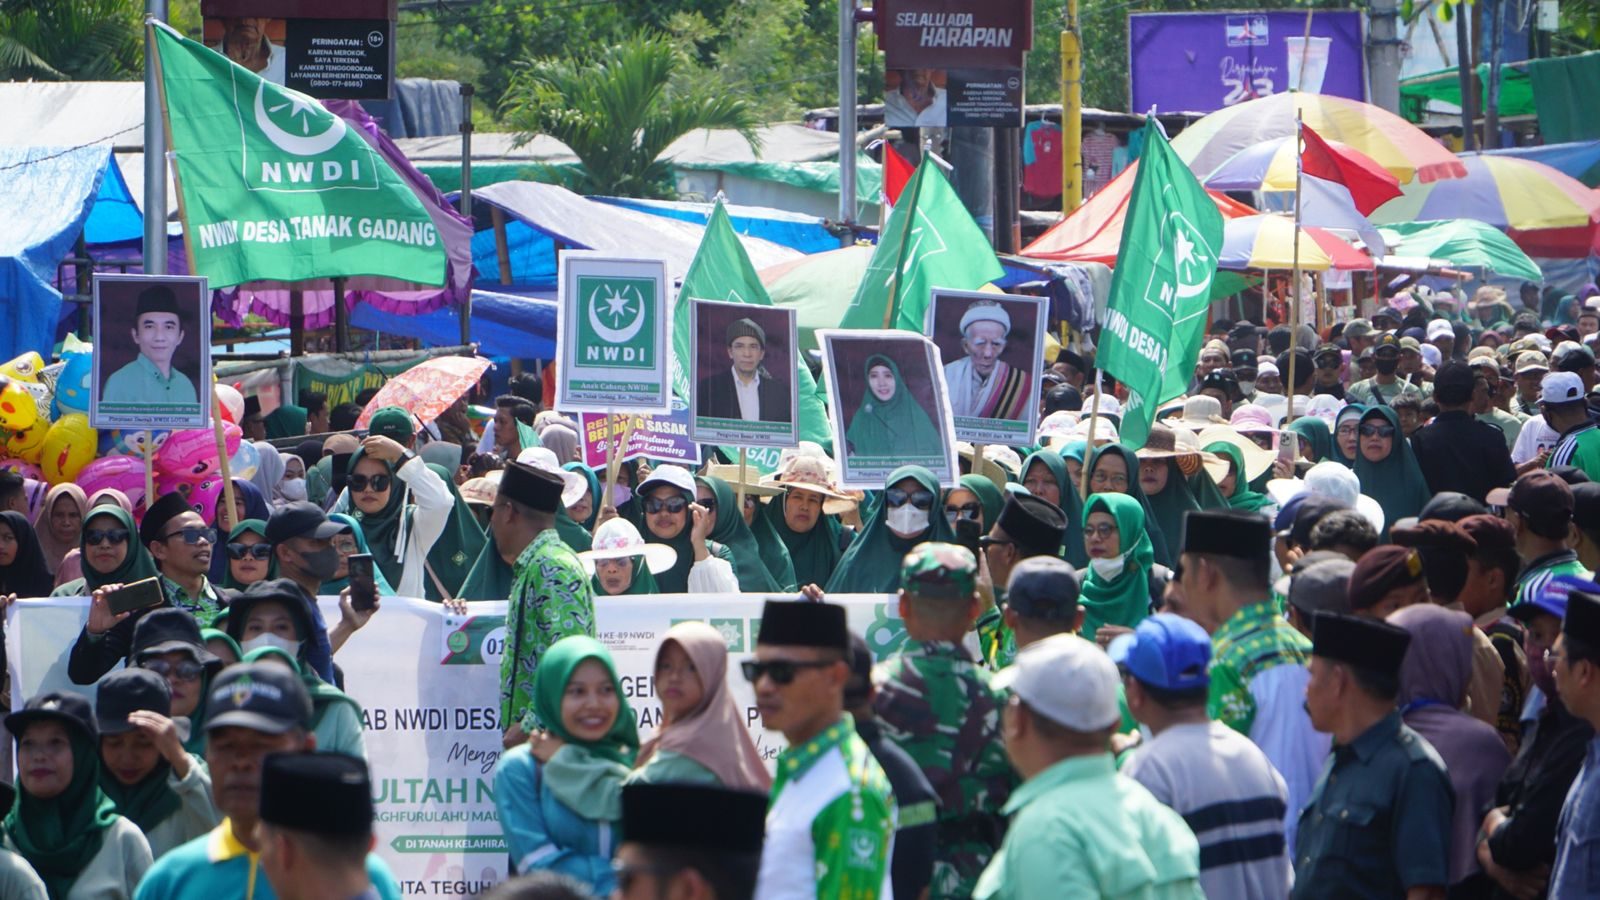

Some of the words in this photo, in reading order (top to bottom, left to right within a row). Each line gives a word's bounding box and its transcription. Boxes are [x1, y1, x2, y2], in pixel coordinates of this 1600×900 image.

[896, 12, 945, 27] SELALU
[947, 13, 973, 27] ADA
[311, 38, 359, 46] PERINGATAN
[920, 27, 1012, 48] HARAPAN
[1220, 55, 1277, 82] Dirgahayu
[261, 160, 360, 183] NWDI
[198, 220, 239, 249] NWDI
[242, 220, 291, 244] DESA
[290, 215, 353, 241] TANAK
[358, 217, 436, 247] GADANG
[586, 345, 645, 362] NWDI
[1128, 326, 1161, 365] DESA
[580, 381, 599, 390] Anak
[646, 420, 688, 436] SASAK
[630, 631, 655, 639] NWDI
[395, 708, 449, 730] NWDI
[405, 839, 417, 849] DI
[418, 839, 454, 849] TANAH
[454, 839, 509, 849] KELAHIRA
[431, 880, 492, 896] TEGUH
